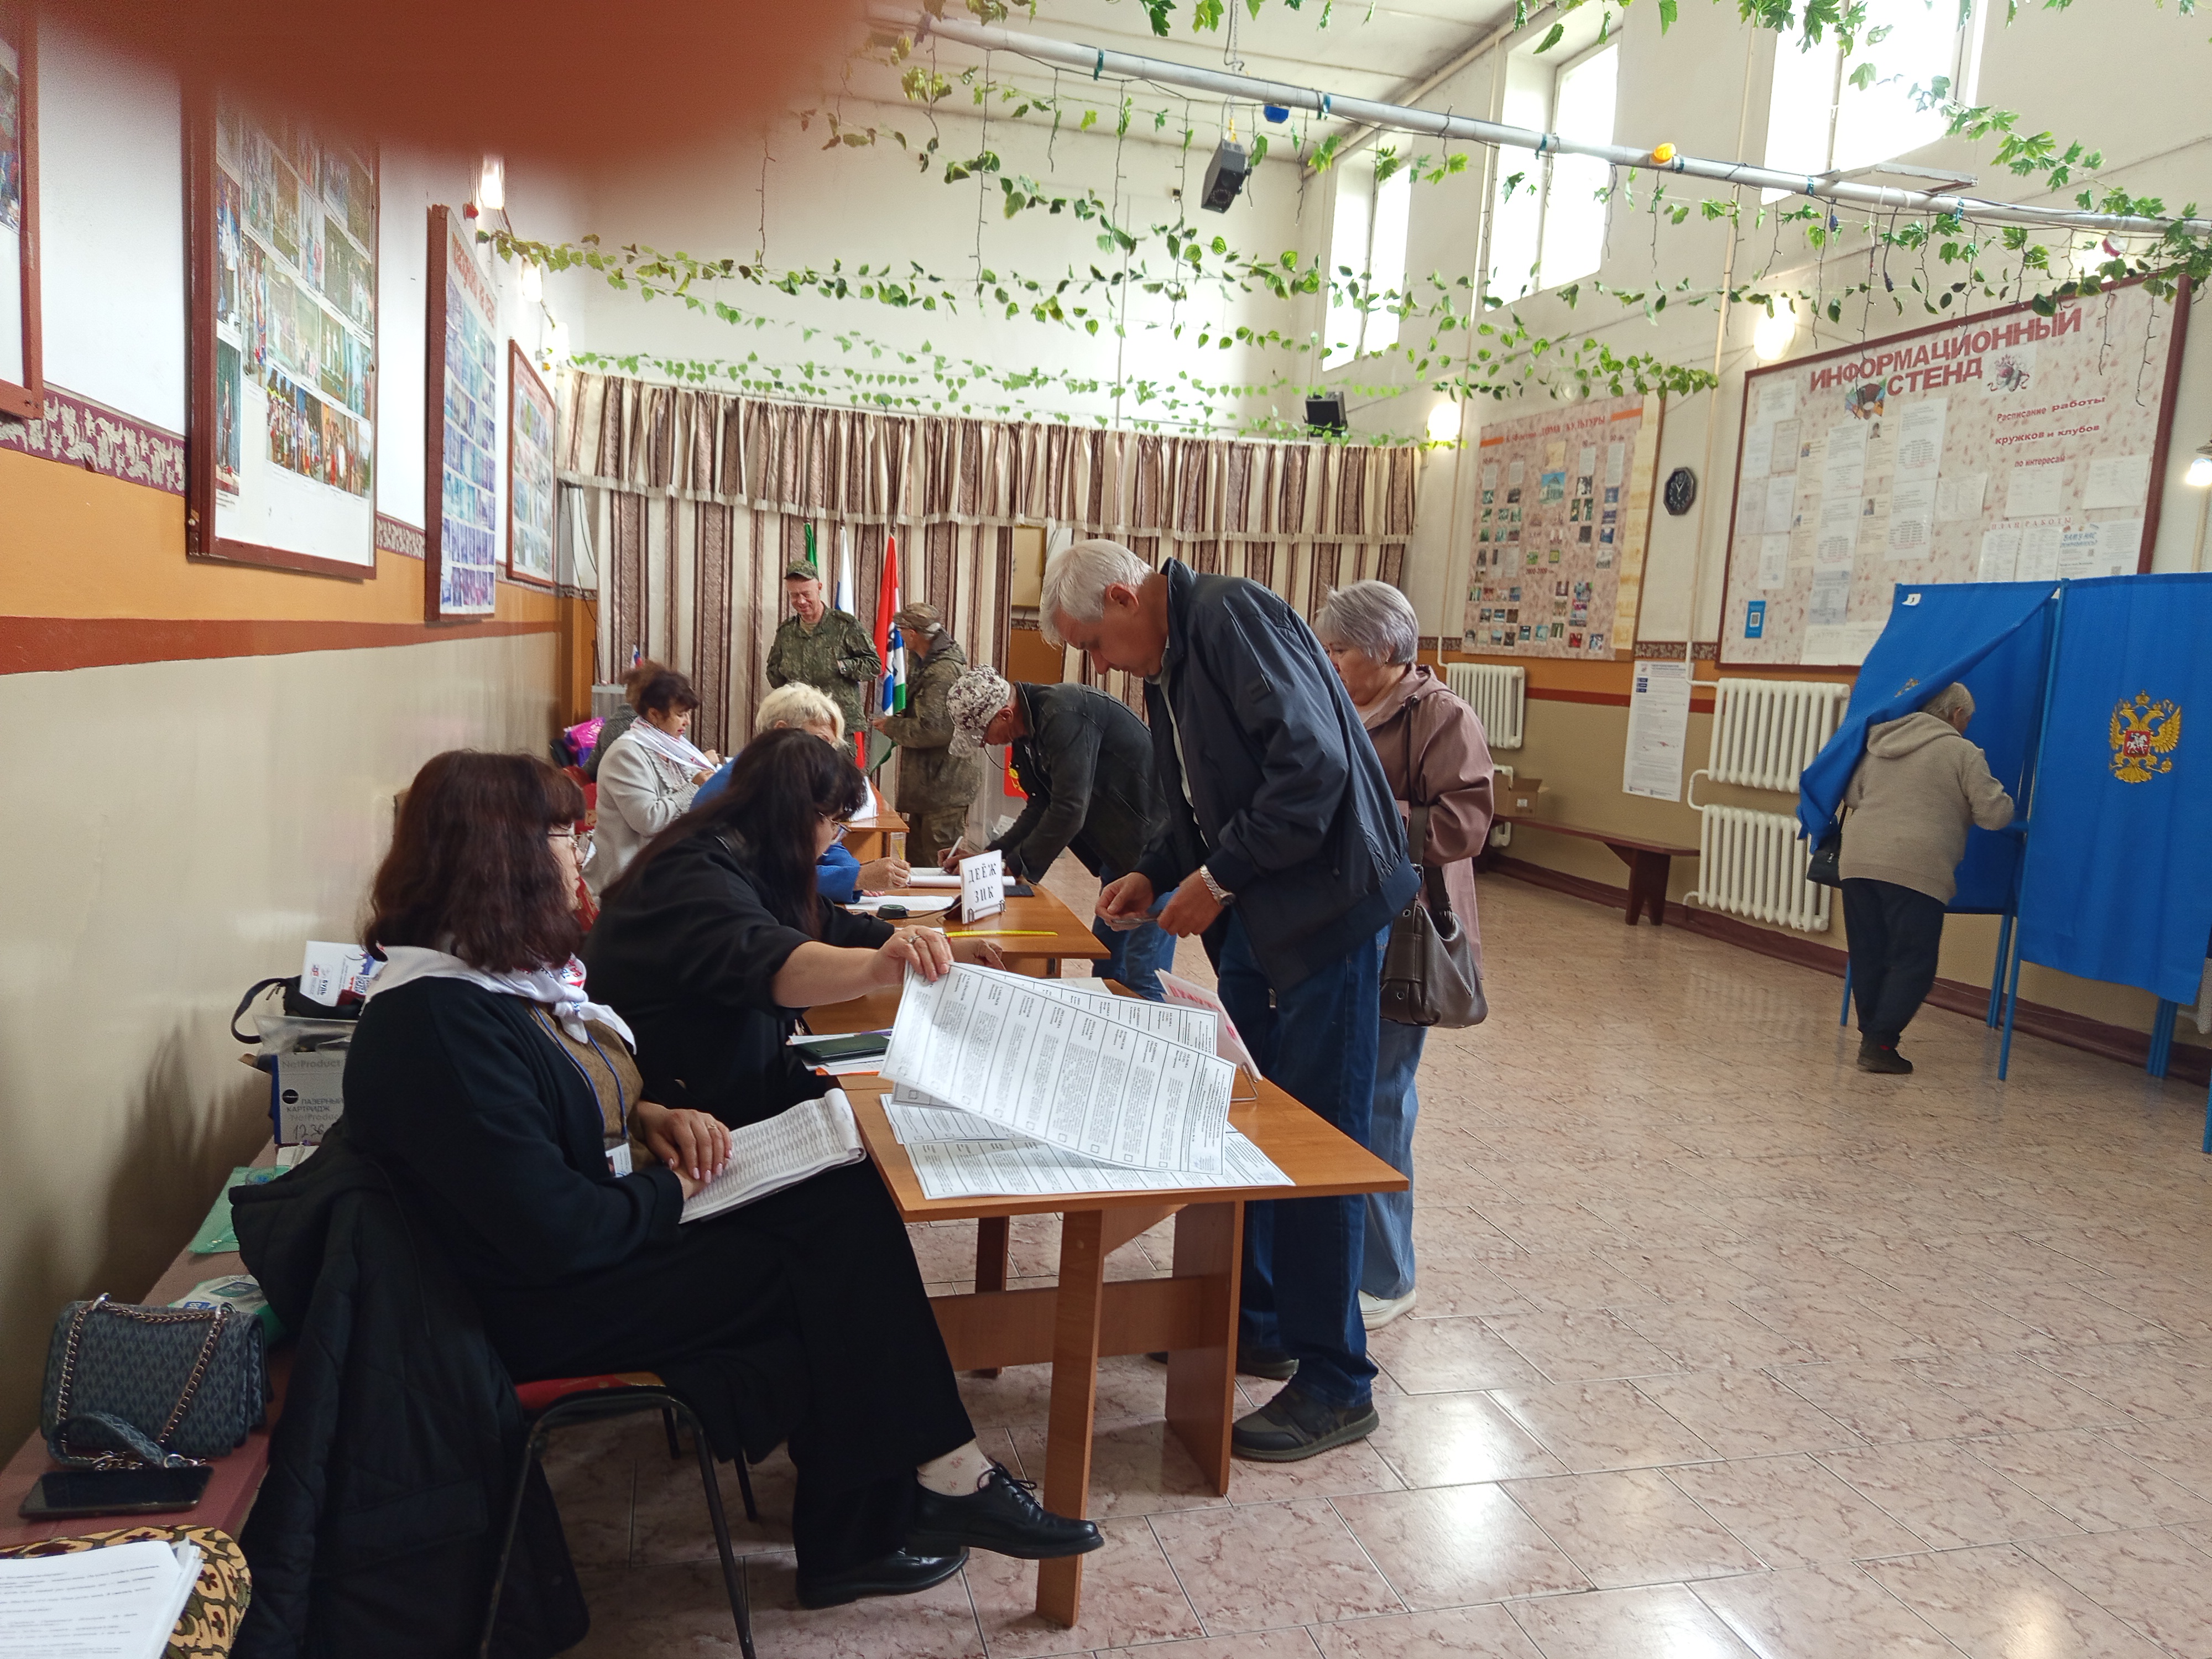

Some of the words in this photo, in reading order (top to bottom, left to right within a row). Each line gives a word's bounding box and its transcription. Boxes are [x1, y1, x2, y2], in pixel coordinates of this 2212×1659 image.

[1809, 304, 2082, 392] ИНФОРМАЦИОННЫЙ
[1886, 357, 1983, 396] СТЕНД
[1996, 407, 2047, 421] Расписание
[2051, 396, 2106, 412] работы
[1995, 431, 2044, 446] кружков
[2058, 425, 2100, 436] клубов
[2025, 455, 2065, 466] интересам
[968, 863, 997, 883] ДЕЁЖ
[974, 885, 994, 903] ЗИК
[282, 1060, 341, 1068] NetProduct
